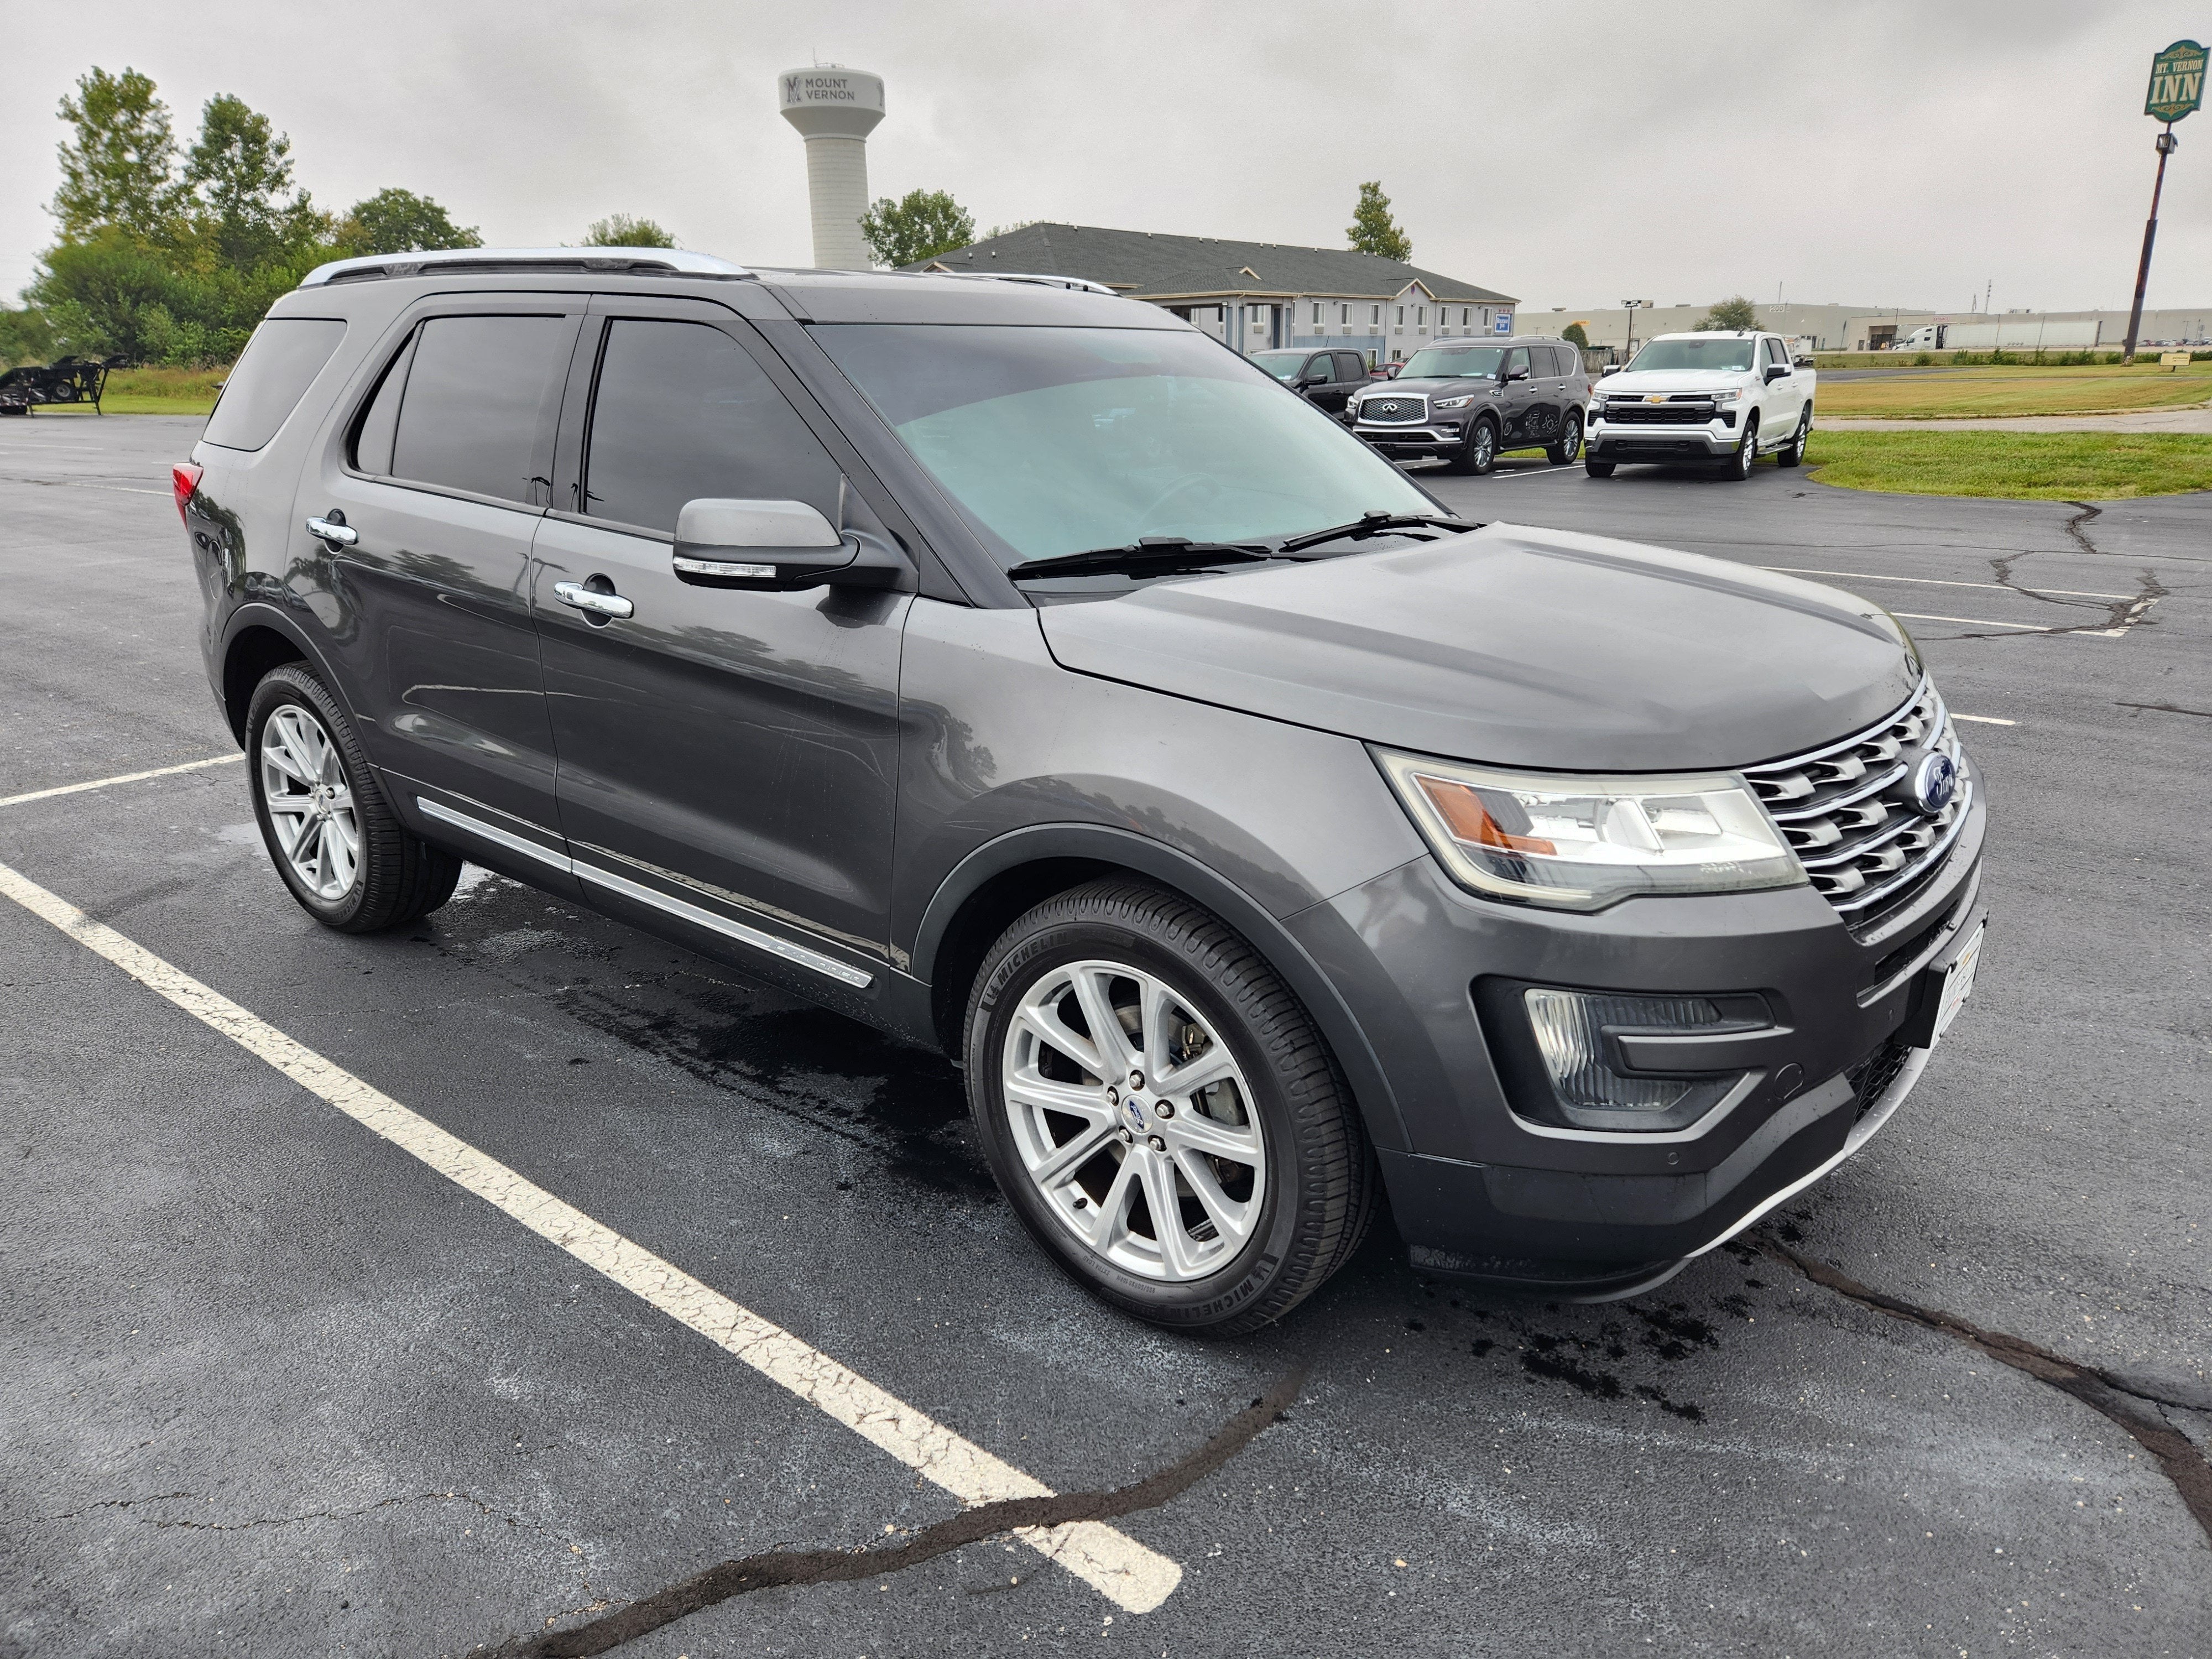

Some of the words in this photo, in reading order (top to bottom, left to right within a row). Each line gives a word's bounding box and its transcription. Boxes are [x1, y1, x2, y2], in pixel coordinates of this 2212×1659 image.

[2156, 64, 2169, 74] MT.
[2173, 59, 2204, 72] VERNON
[806, 78, 848, 88] MOUNT
[806, 90, 854, 101] VERNON
[2150, 72, 2203, 104] INN
[1933, 761, 1953, 800] Ford
[997, 932, 1068, 986] MICHELIN
[1130, 1105, 1144, 1125] Ford
[1170, 1279, 1255, 1319] MICHELIN
